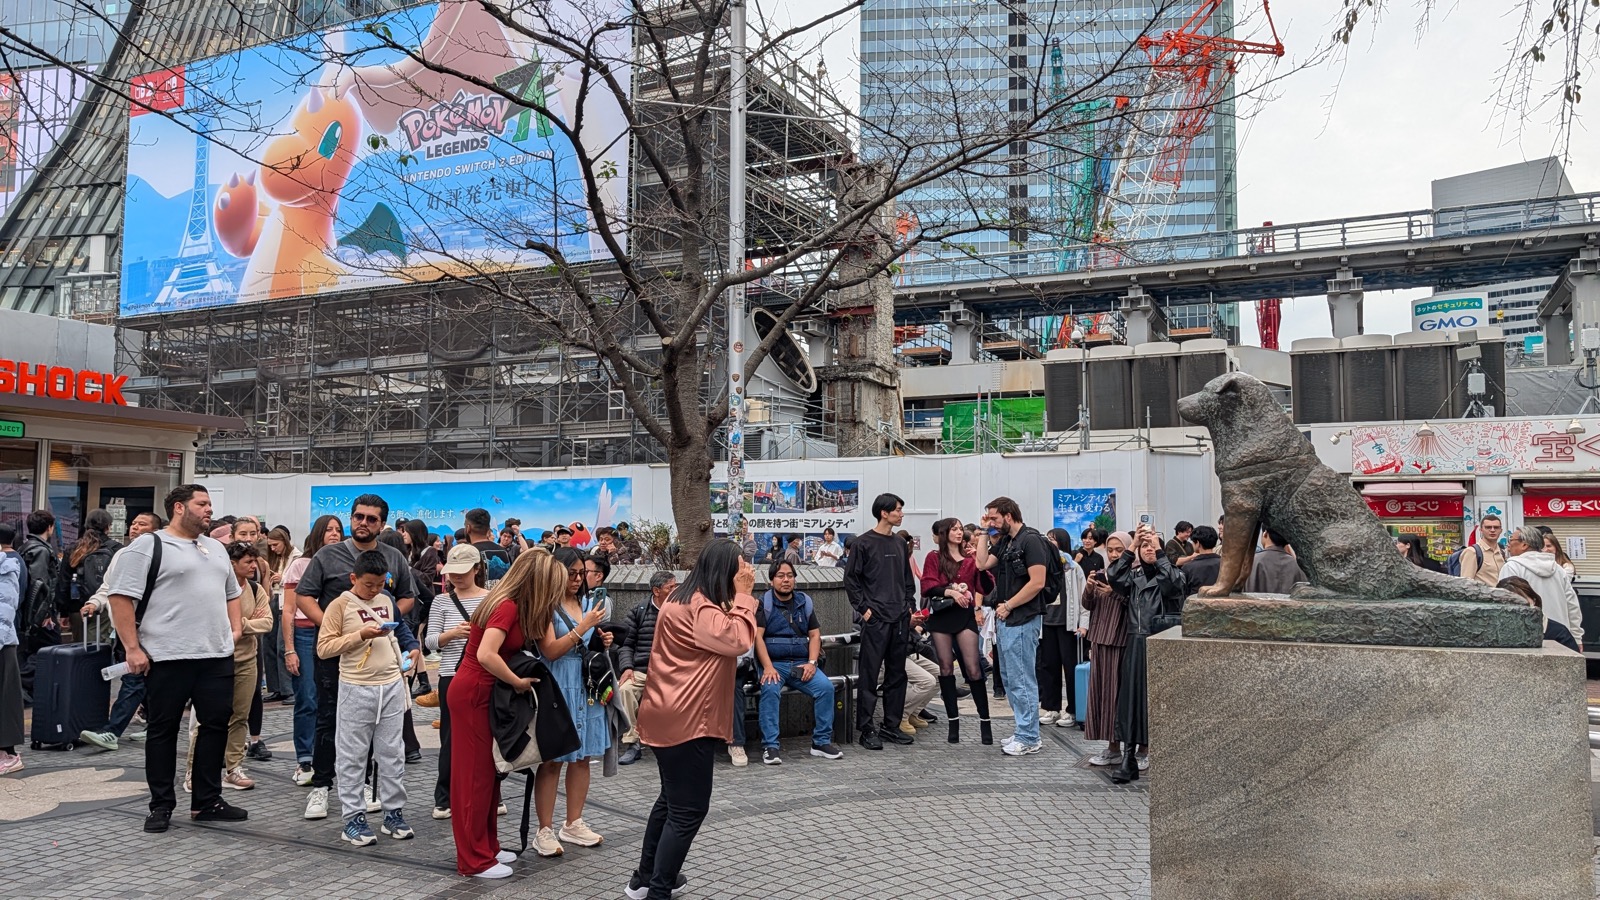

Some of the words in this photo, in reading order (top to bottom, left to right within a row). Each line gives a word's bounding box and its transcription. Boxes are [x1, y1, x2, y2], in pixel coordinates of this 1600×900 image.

[426, 136, 489, 159] LEGENDS
[400, 167, 452, 184] NINTENDO
[455, 159, 496, 176] SWITCH
[509, 150, 553, 166] EDITION
[1416, 301, 1480, 313] ネットのセキュリティも
[1420, 315, 1478, 331] GMO
[317, 496, 358, 508] ミアレシ
[1058, 493, 1111, 502] ミアレシティが
[1057, 503, 1111, 513] 生まれ変わる
[1402, 500, 1440, 512] 宝くじ
